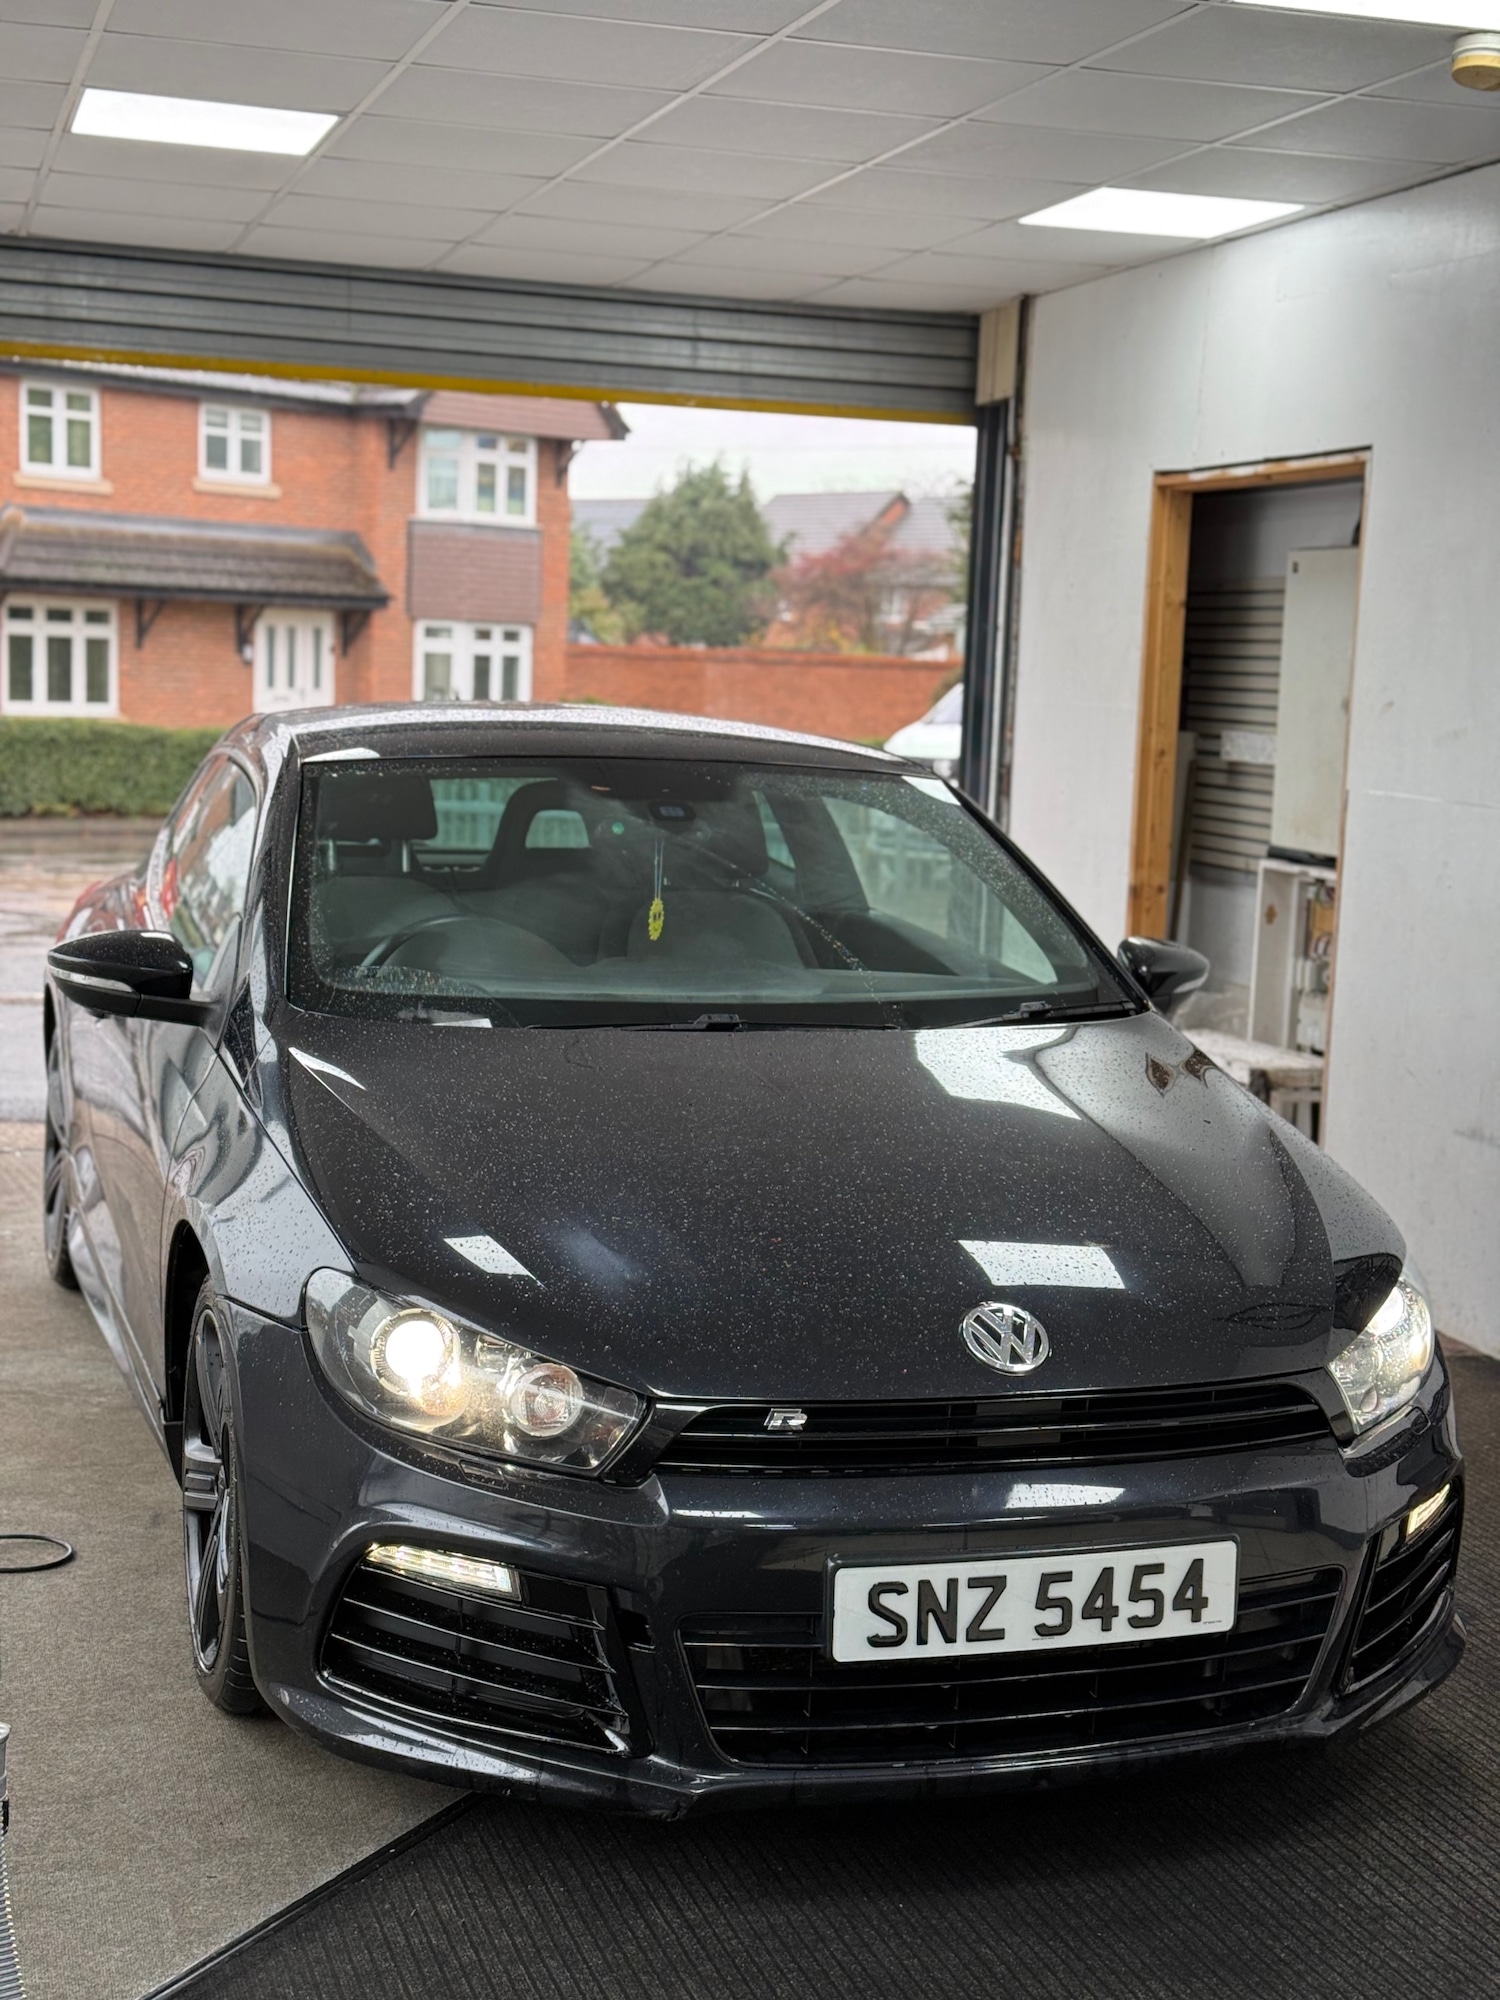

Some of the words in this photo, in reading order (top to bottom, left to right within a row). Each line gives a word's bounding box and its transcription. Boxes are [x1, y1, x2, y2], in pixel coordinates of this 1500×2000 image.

[764, 1408, 808, 1431] R
[867, 1575, 1007, 1648] SNZ
[1034, 1559, 1209, 1637] 5454
